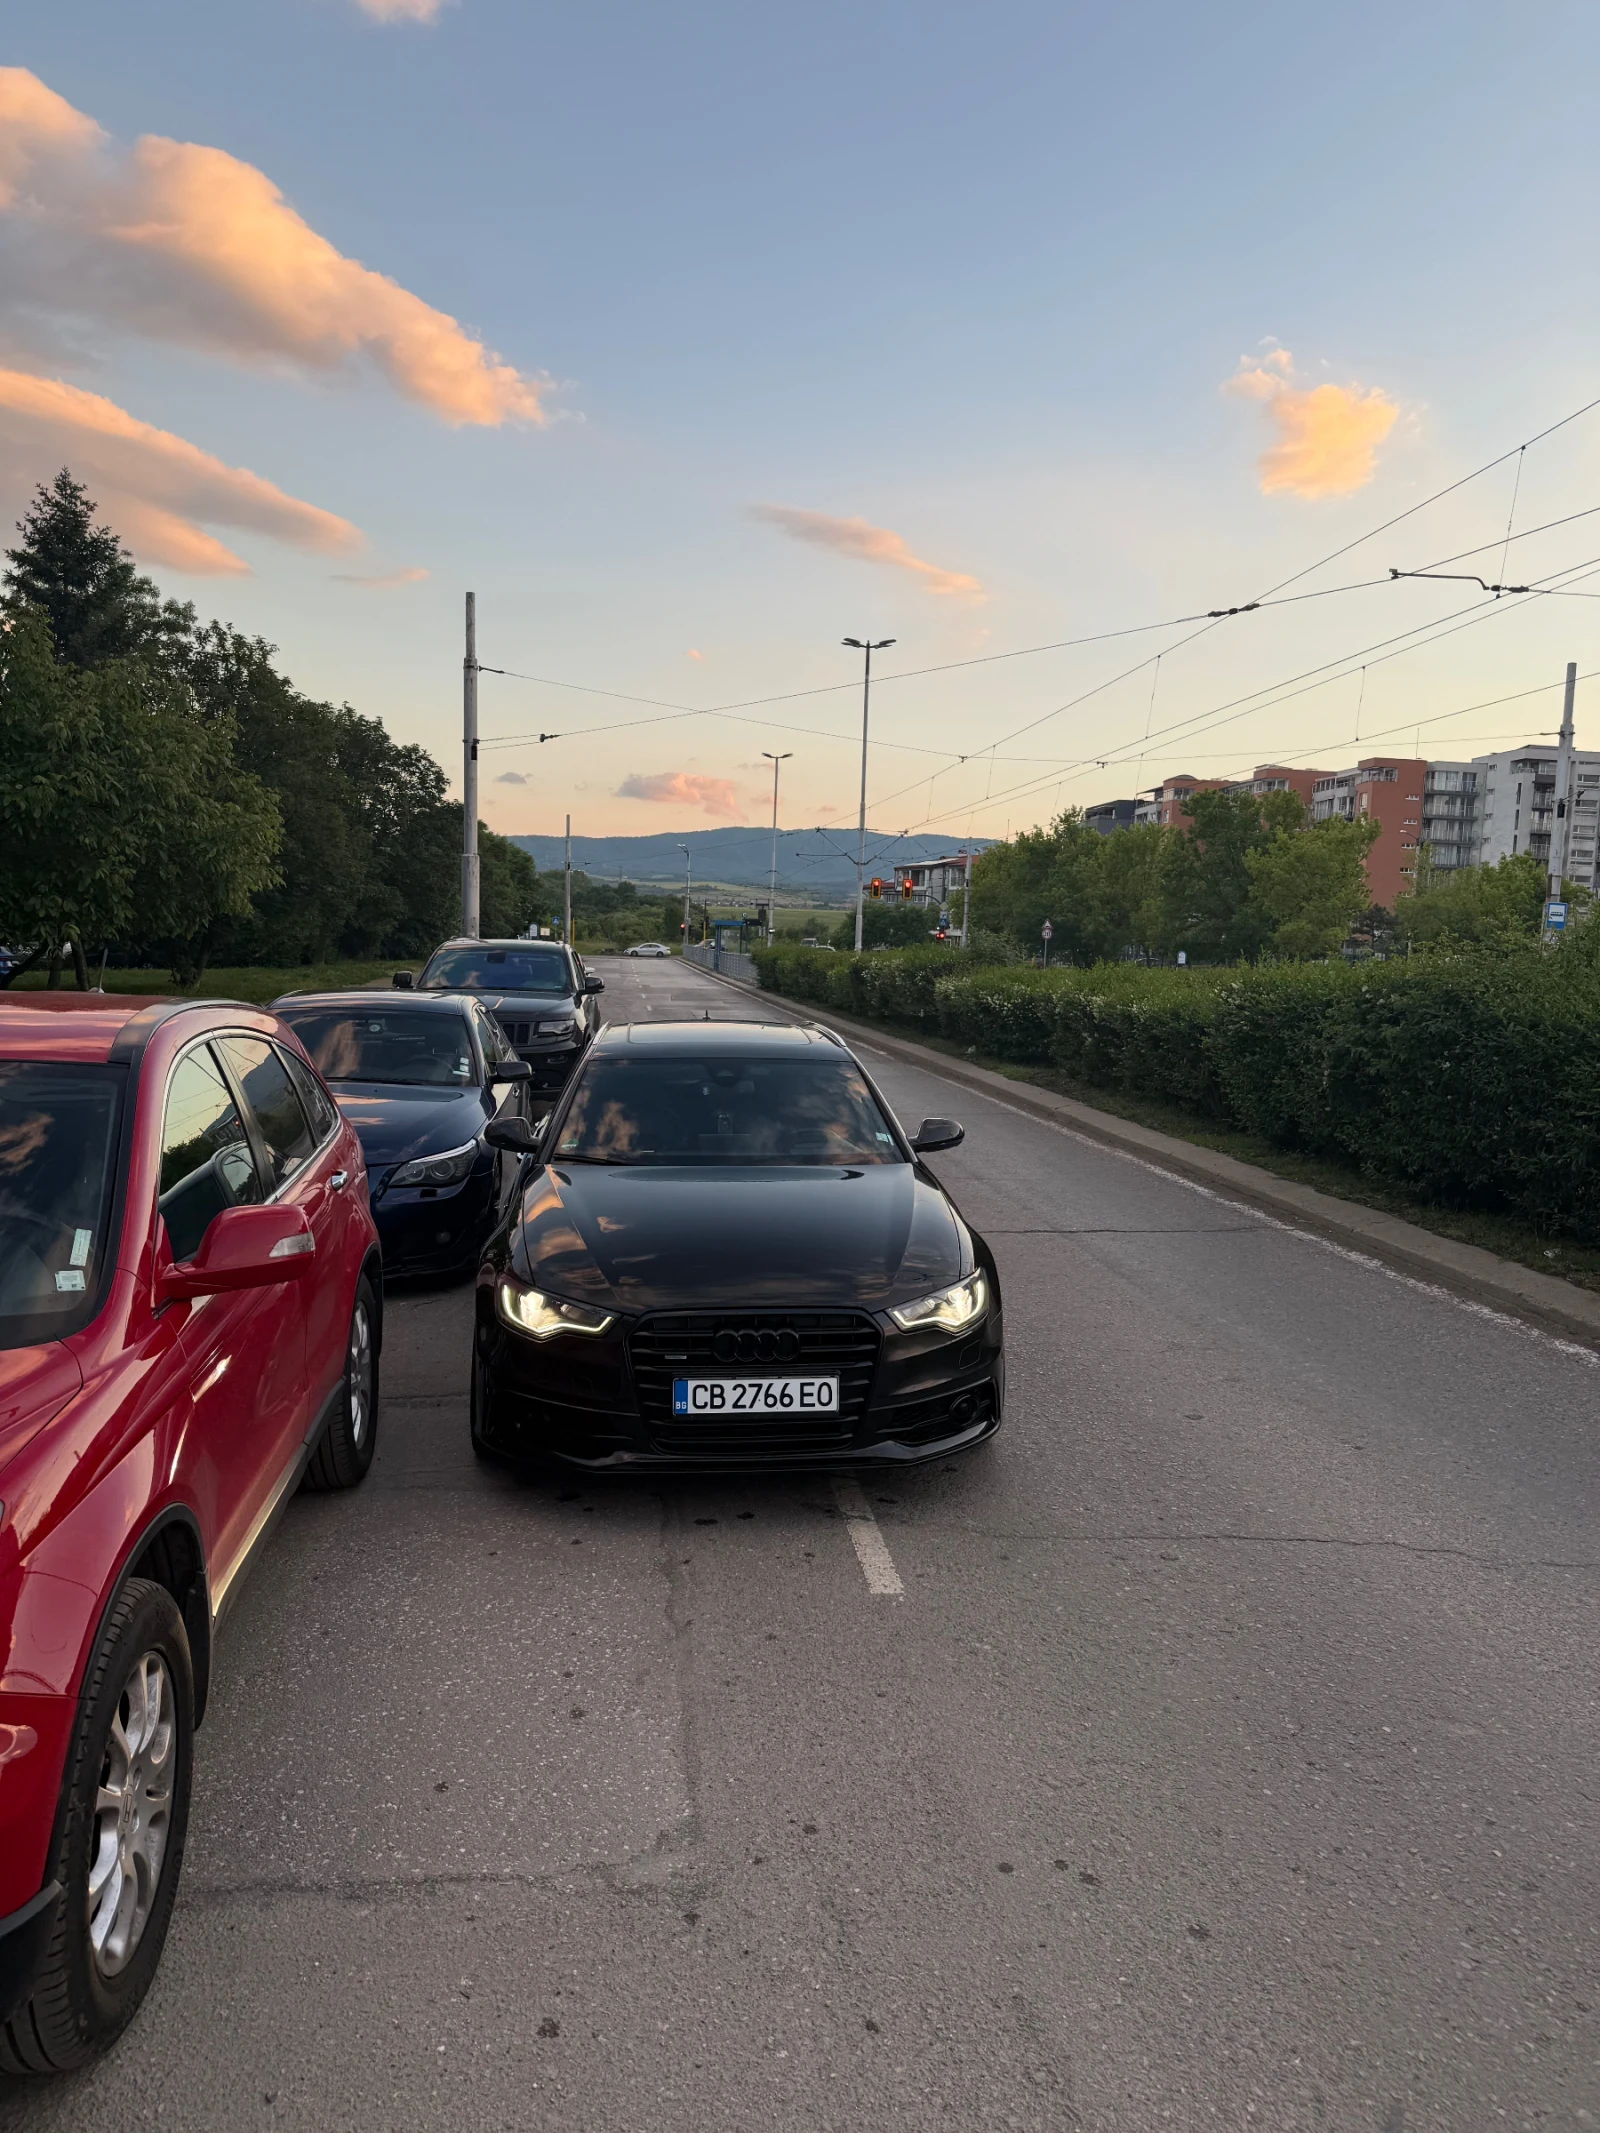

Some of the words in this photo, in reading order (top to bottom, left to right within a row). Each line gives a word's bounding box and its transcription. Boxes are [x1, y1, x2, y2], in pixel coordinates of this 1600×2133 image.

[692, 1384, 726, 1410] CB
[732, 1382, 794, 1409] 2766
[800, 1382, 833, 1408] EO
[675, 1401, 687, 1410] BG
